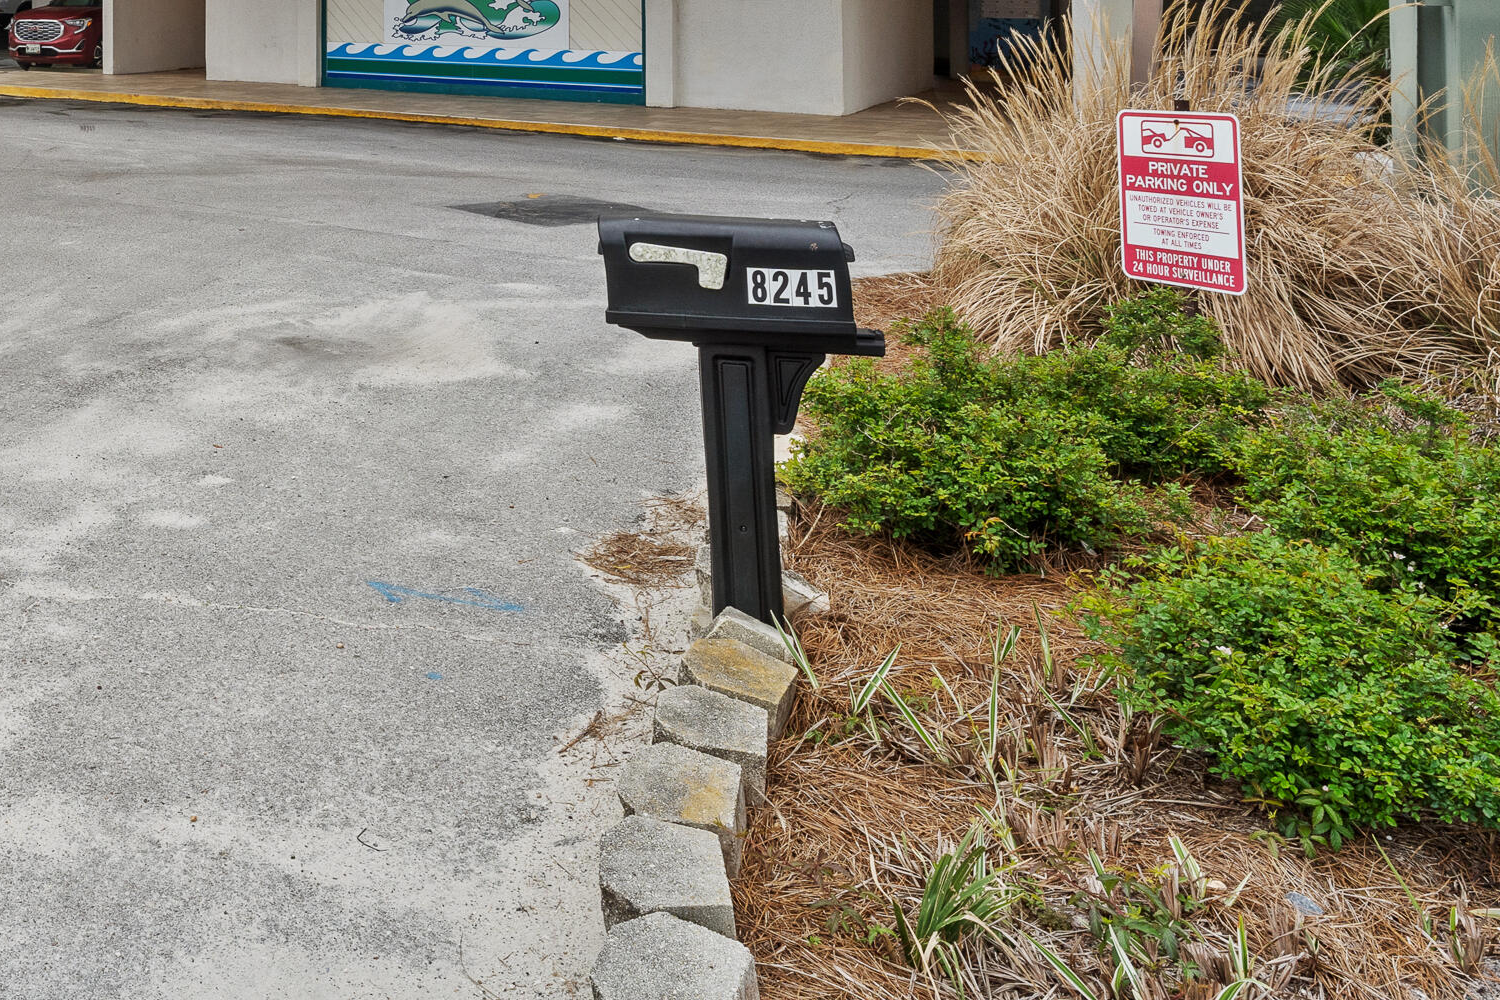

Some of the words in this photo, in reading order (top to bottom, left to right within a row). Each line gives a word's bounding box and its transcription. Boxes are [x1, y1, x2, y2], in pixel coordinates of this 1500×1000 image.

[1148, 161, 1208, 178] PRIVATE
[1126, 174, 1187, 192] PARKING
[1192, 180, 1233, 196] ONLY
[1129, 195, 1174, 205] UNAUTHORIZED
[1176, 200, 1205, 209] VEHICLES
[1207, 202, 1221, 211] WILL
[1138, 204, 1157, 213] TOWED
[1168, 207, 1193, 217] VEHICLE
[1196, 211, 1223, 220] OWNER'S
[1153, 215, 1190, 226] OPERATOR'S
[1192, 220, 1219, 229] EXPENSE
[1153, 228, 1175, 238] TOWING
[1177, 230, 1210, 242] ENFORCED
[1171, 239, 1182, 247] ALL
[1184, 241, 1202, 250] TIMES
[1135, 249, 1154, 261] THIS
[1157, 251, 1198, 268] PROPERTY
[1201, 259, 1231, 273] UNDER
[1132, 261, 1144, 273] 24
[1147, 263, 1170, 277] HOUR
[1172, 266, 1235, 287] SURVEILLANCE
[751, 269, 834, 305] 8245
